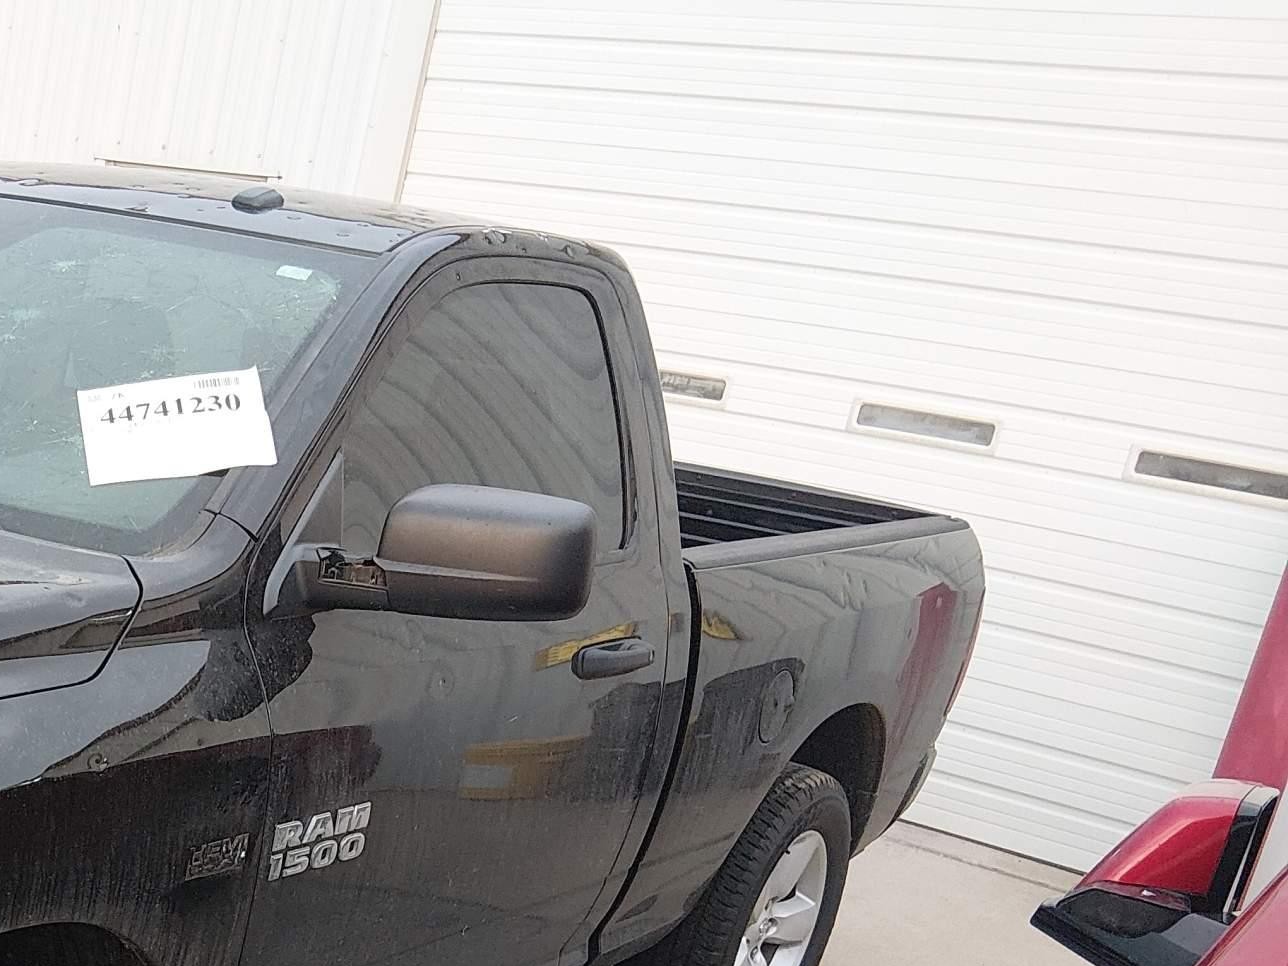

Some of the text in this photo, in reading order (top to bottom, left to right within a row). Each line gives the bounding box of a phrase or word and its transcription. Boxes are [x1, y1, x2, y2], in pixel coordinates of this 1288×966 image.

[100, 393, 241, 424] 44741230
[272, 801, 372, 852] RAM
[268, 832, 366, 882] 1500
